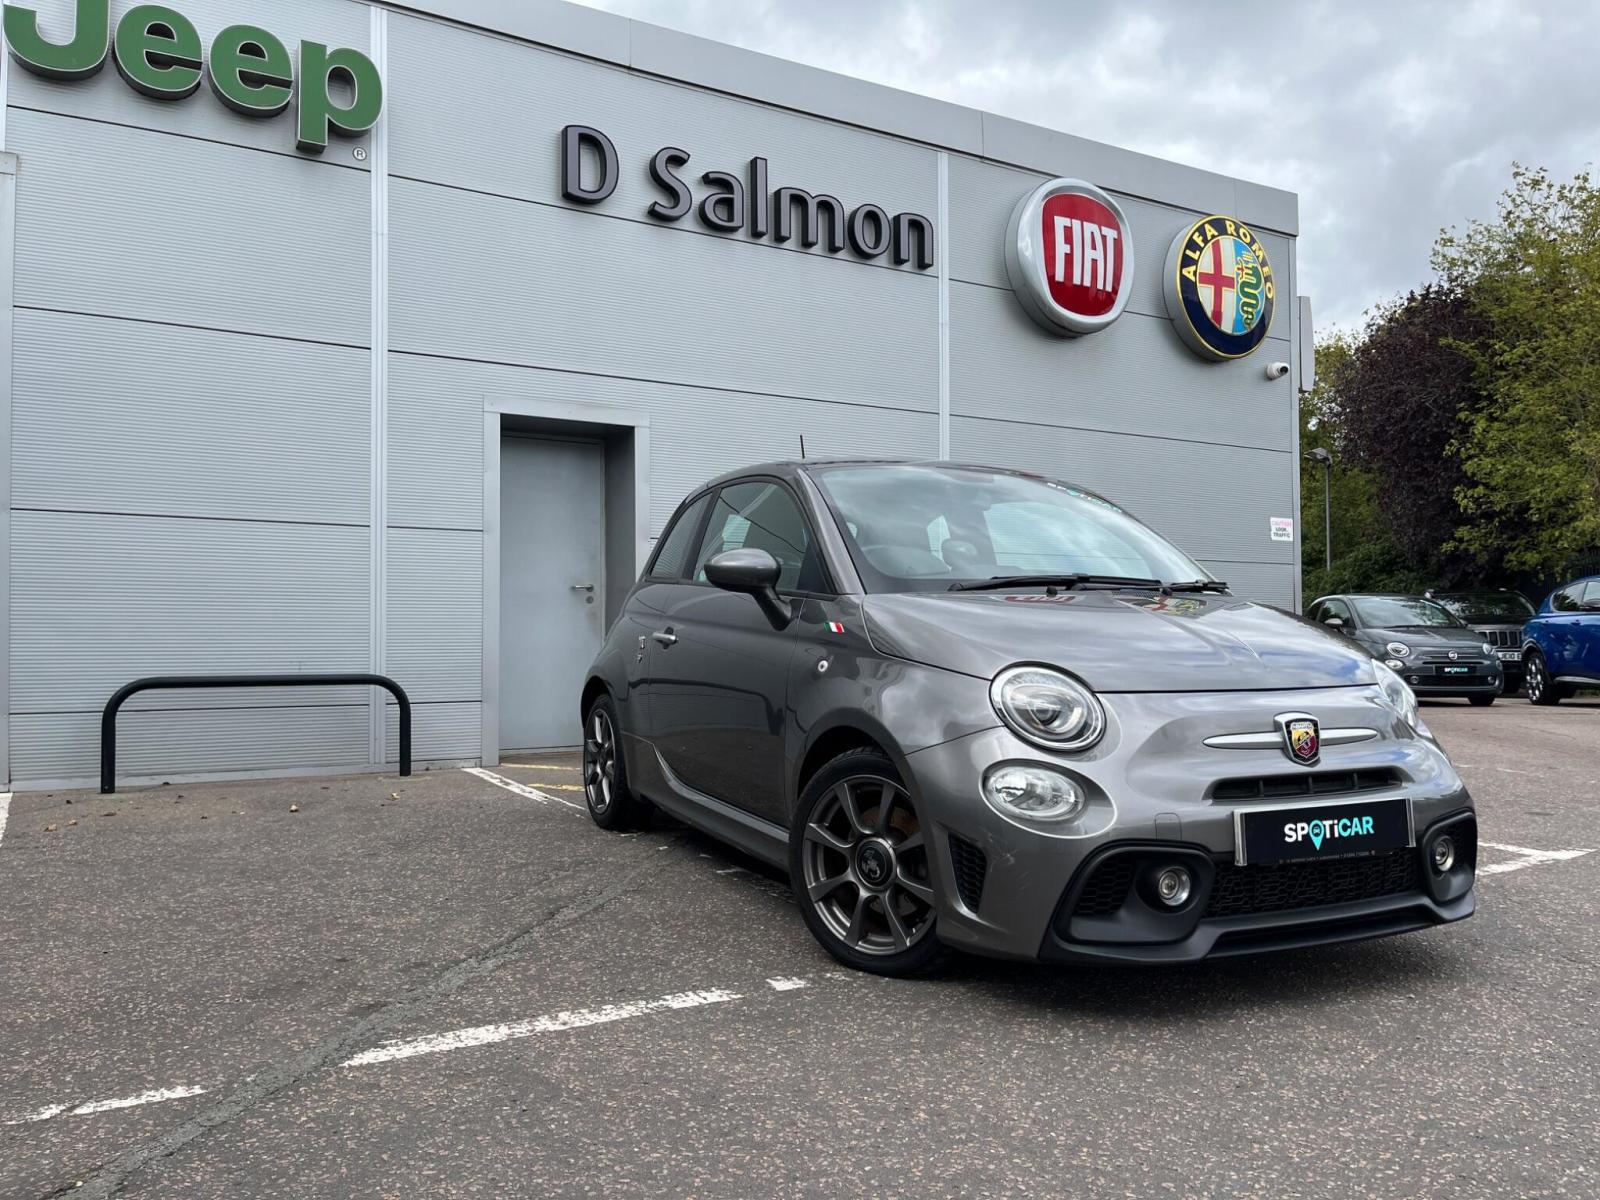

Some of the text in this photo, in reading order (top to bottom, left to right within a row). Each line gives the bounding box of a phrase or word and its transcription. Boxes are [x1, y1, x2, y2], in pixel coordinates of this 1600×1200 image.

[2, 0, 383, 153] Jeep
[560, 124, 934, 270] D Salmon
[1054, 215, 1118, 292] FIAT
[1182, 220, 1274, 299] ALFA ROMEO
